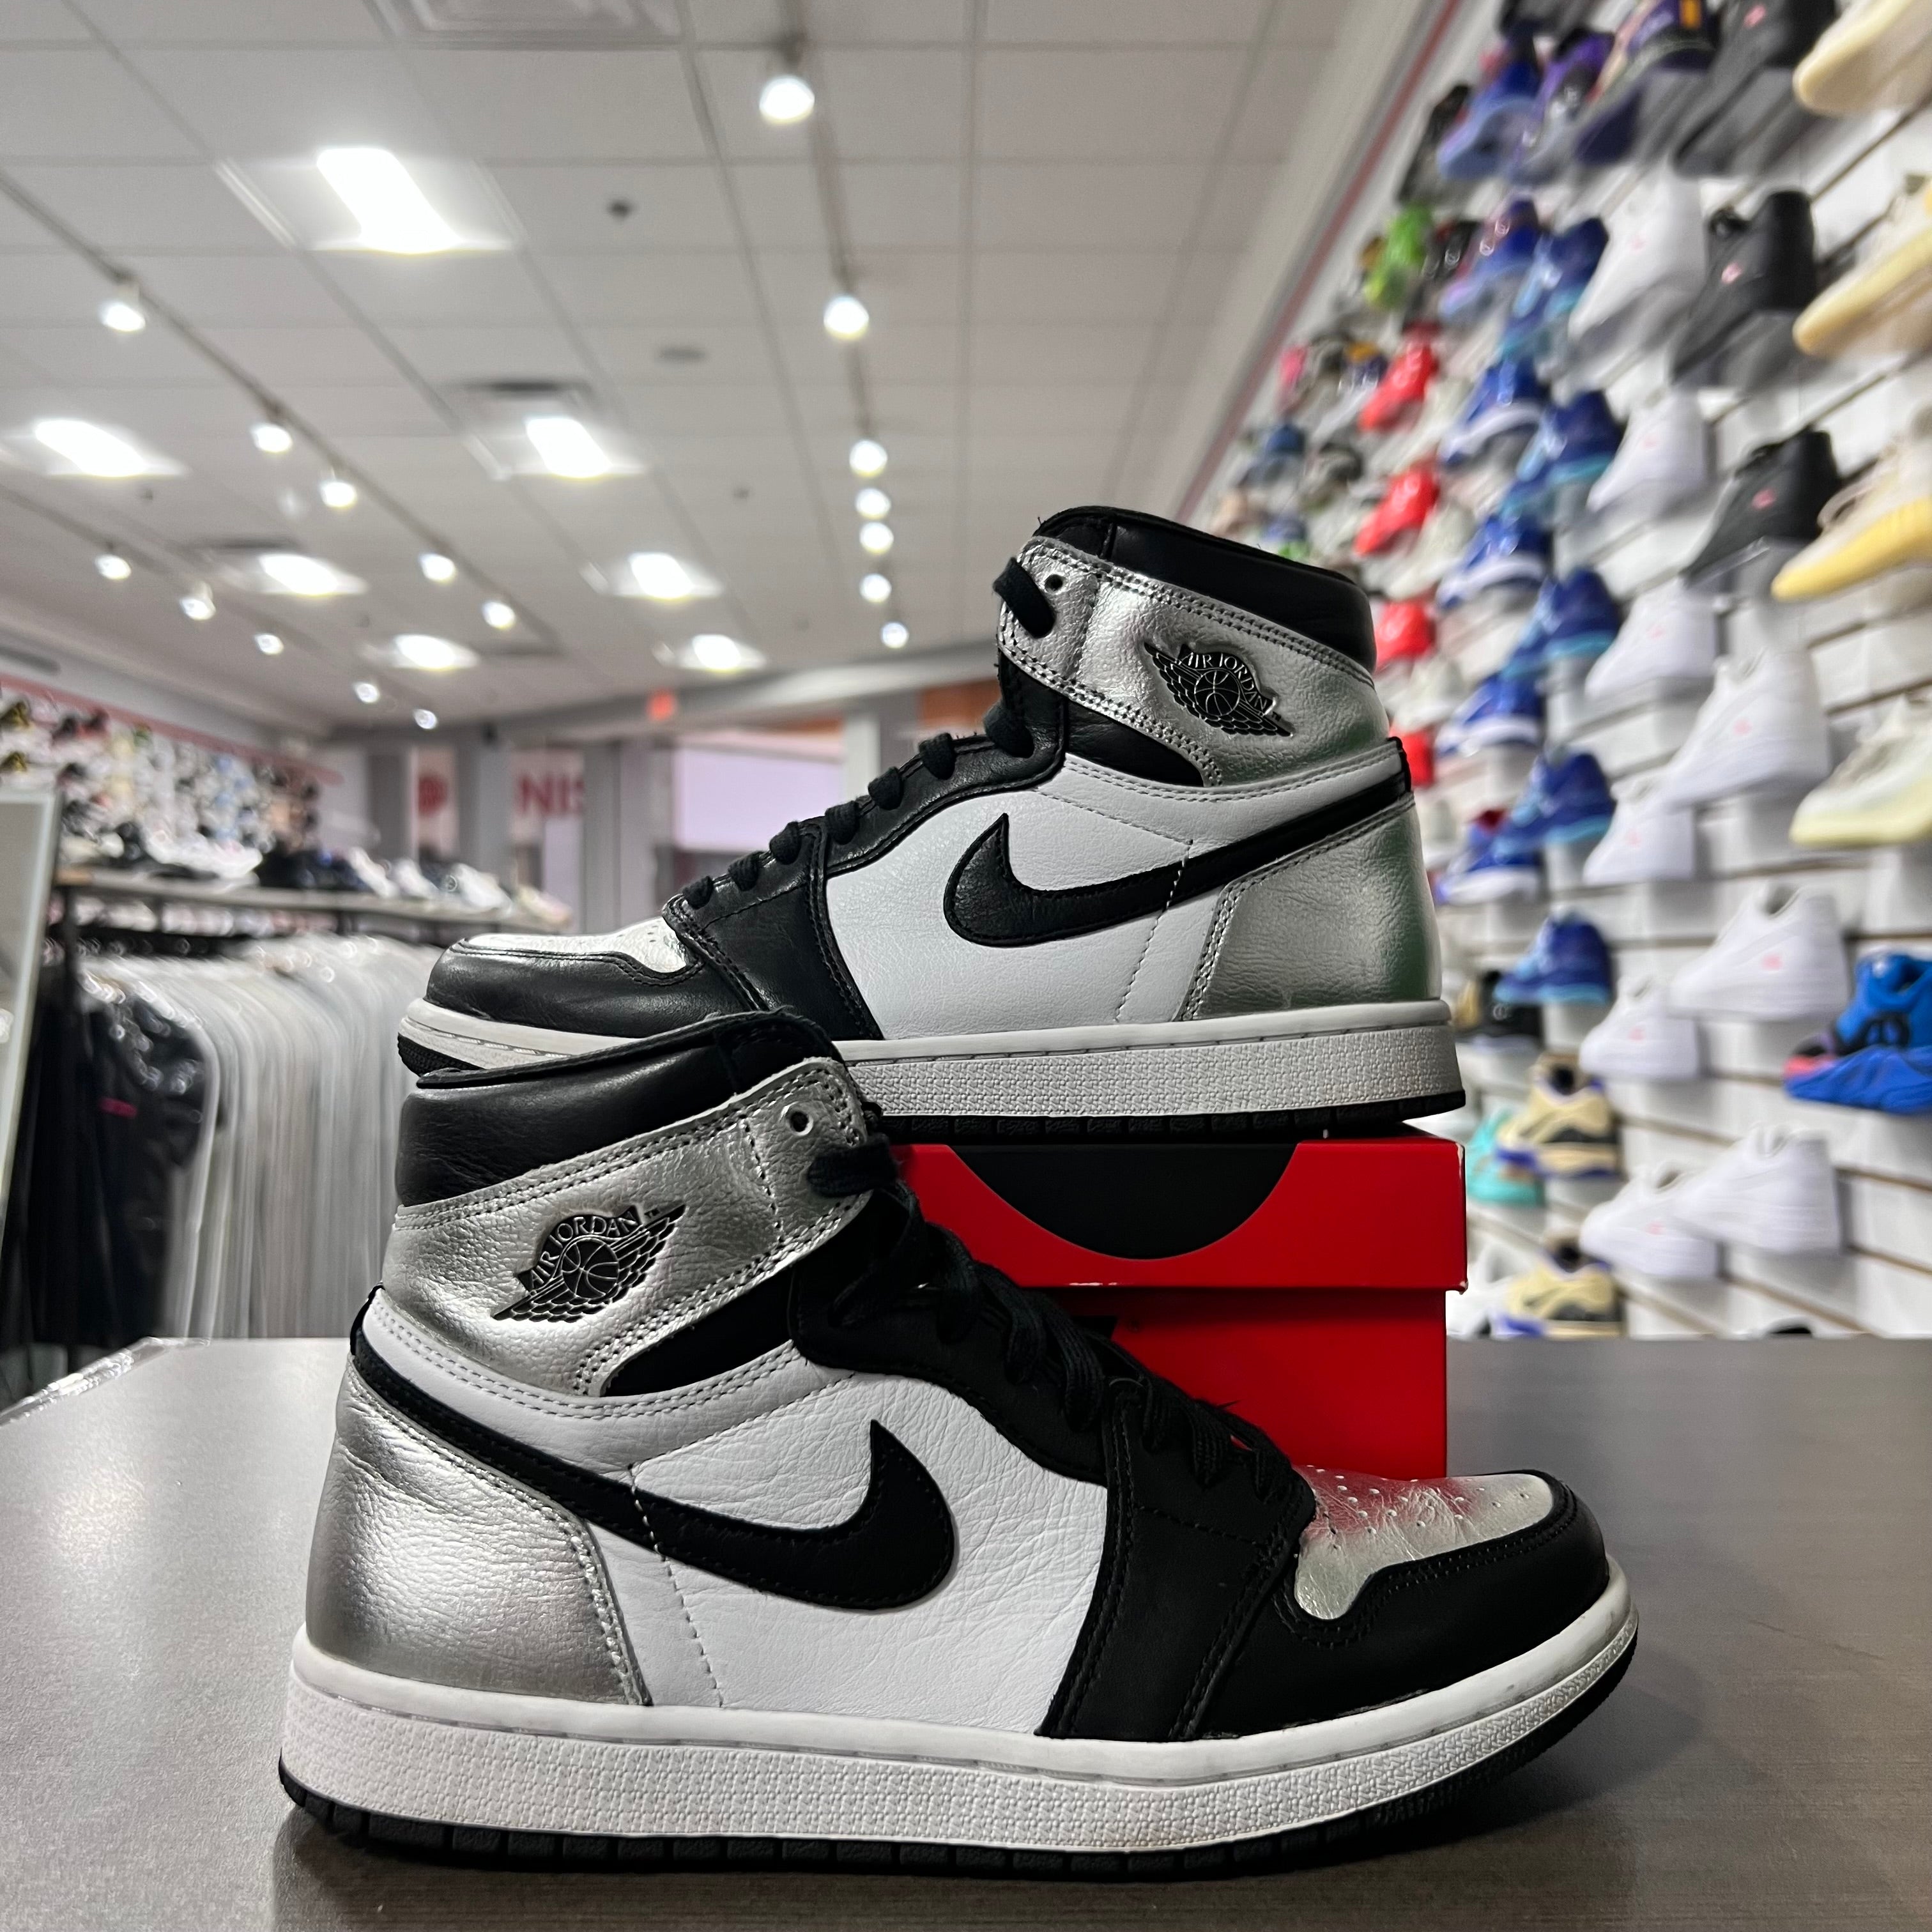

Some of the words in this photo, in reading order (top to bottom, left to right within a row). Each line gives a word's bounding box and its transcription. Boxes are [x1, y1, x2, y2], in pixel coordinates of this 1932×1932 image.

[1181, 652, 1213, 668] AIR
[1219, 653, 1267, 710] JORDAN
[531, 1250, 560, 1287] AIR
[549, 1213, 638, 1248] JORDAN
